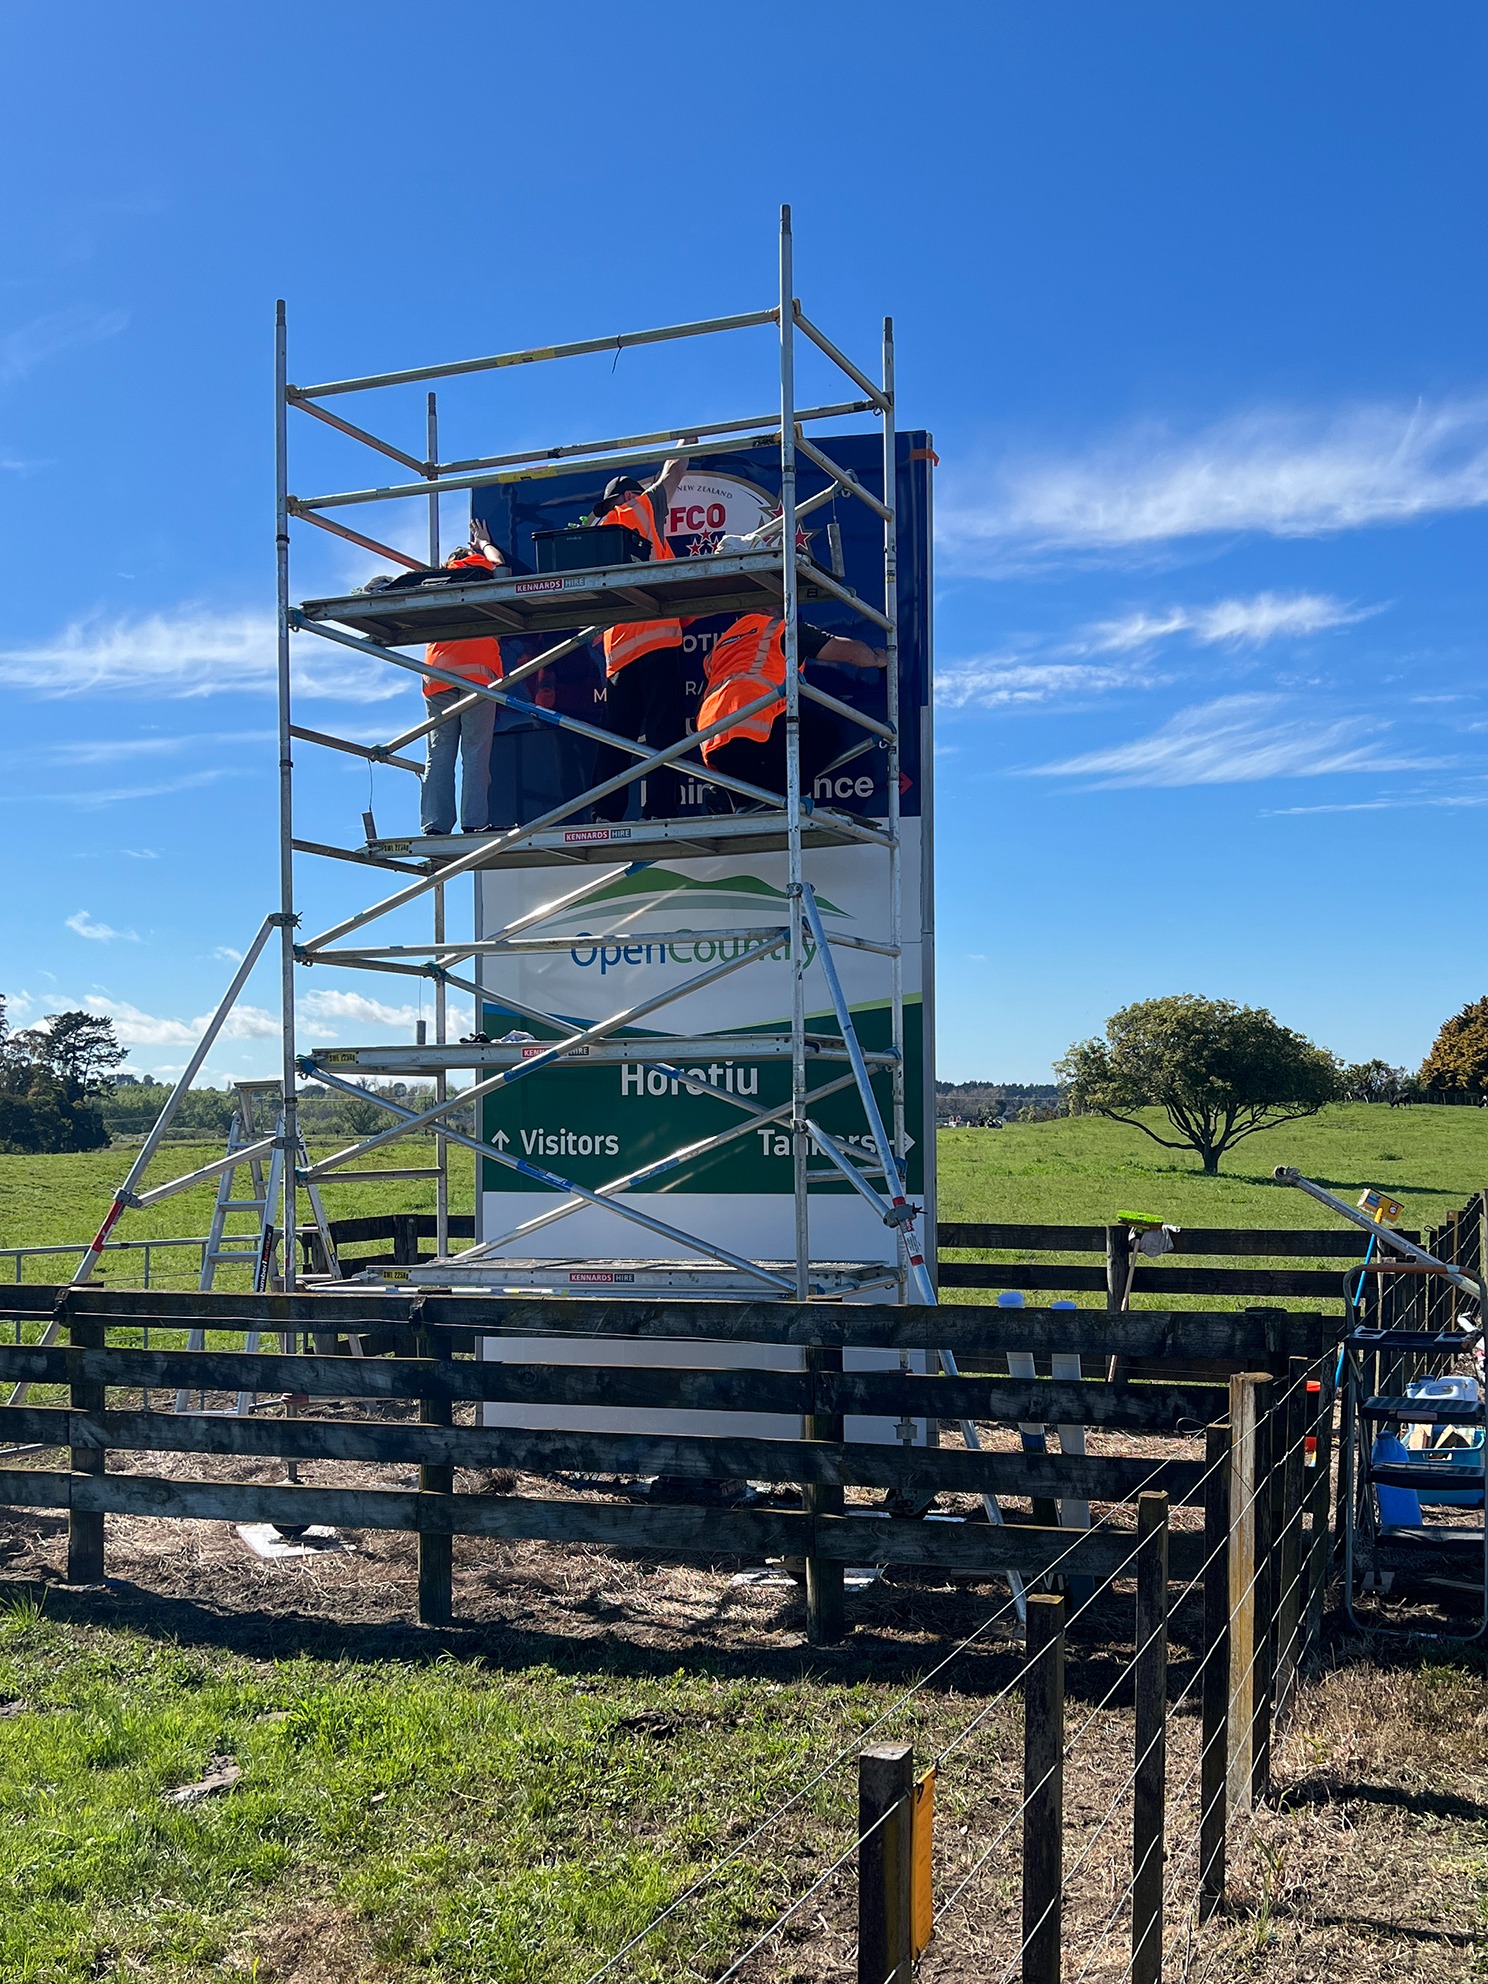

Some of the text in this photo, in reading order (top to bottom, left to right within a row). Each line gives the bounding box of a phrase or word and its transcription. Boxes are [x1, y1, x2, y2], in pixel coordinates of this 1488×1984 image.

[677, 485, 733, 499] NEW ZEALAND
[665, 502, 726, 532] FCO
[517, 577, 584, 593] KENNARDS HIRE
[566, 829, 630, 841] KENNARDS HIRE
[520, 1128, 619, 1155] Visitors
[757, 1129, 877, 1156] Takrs
[571, 1274, 633, 1282] KENNARDS HIRE
